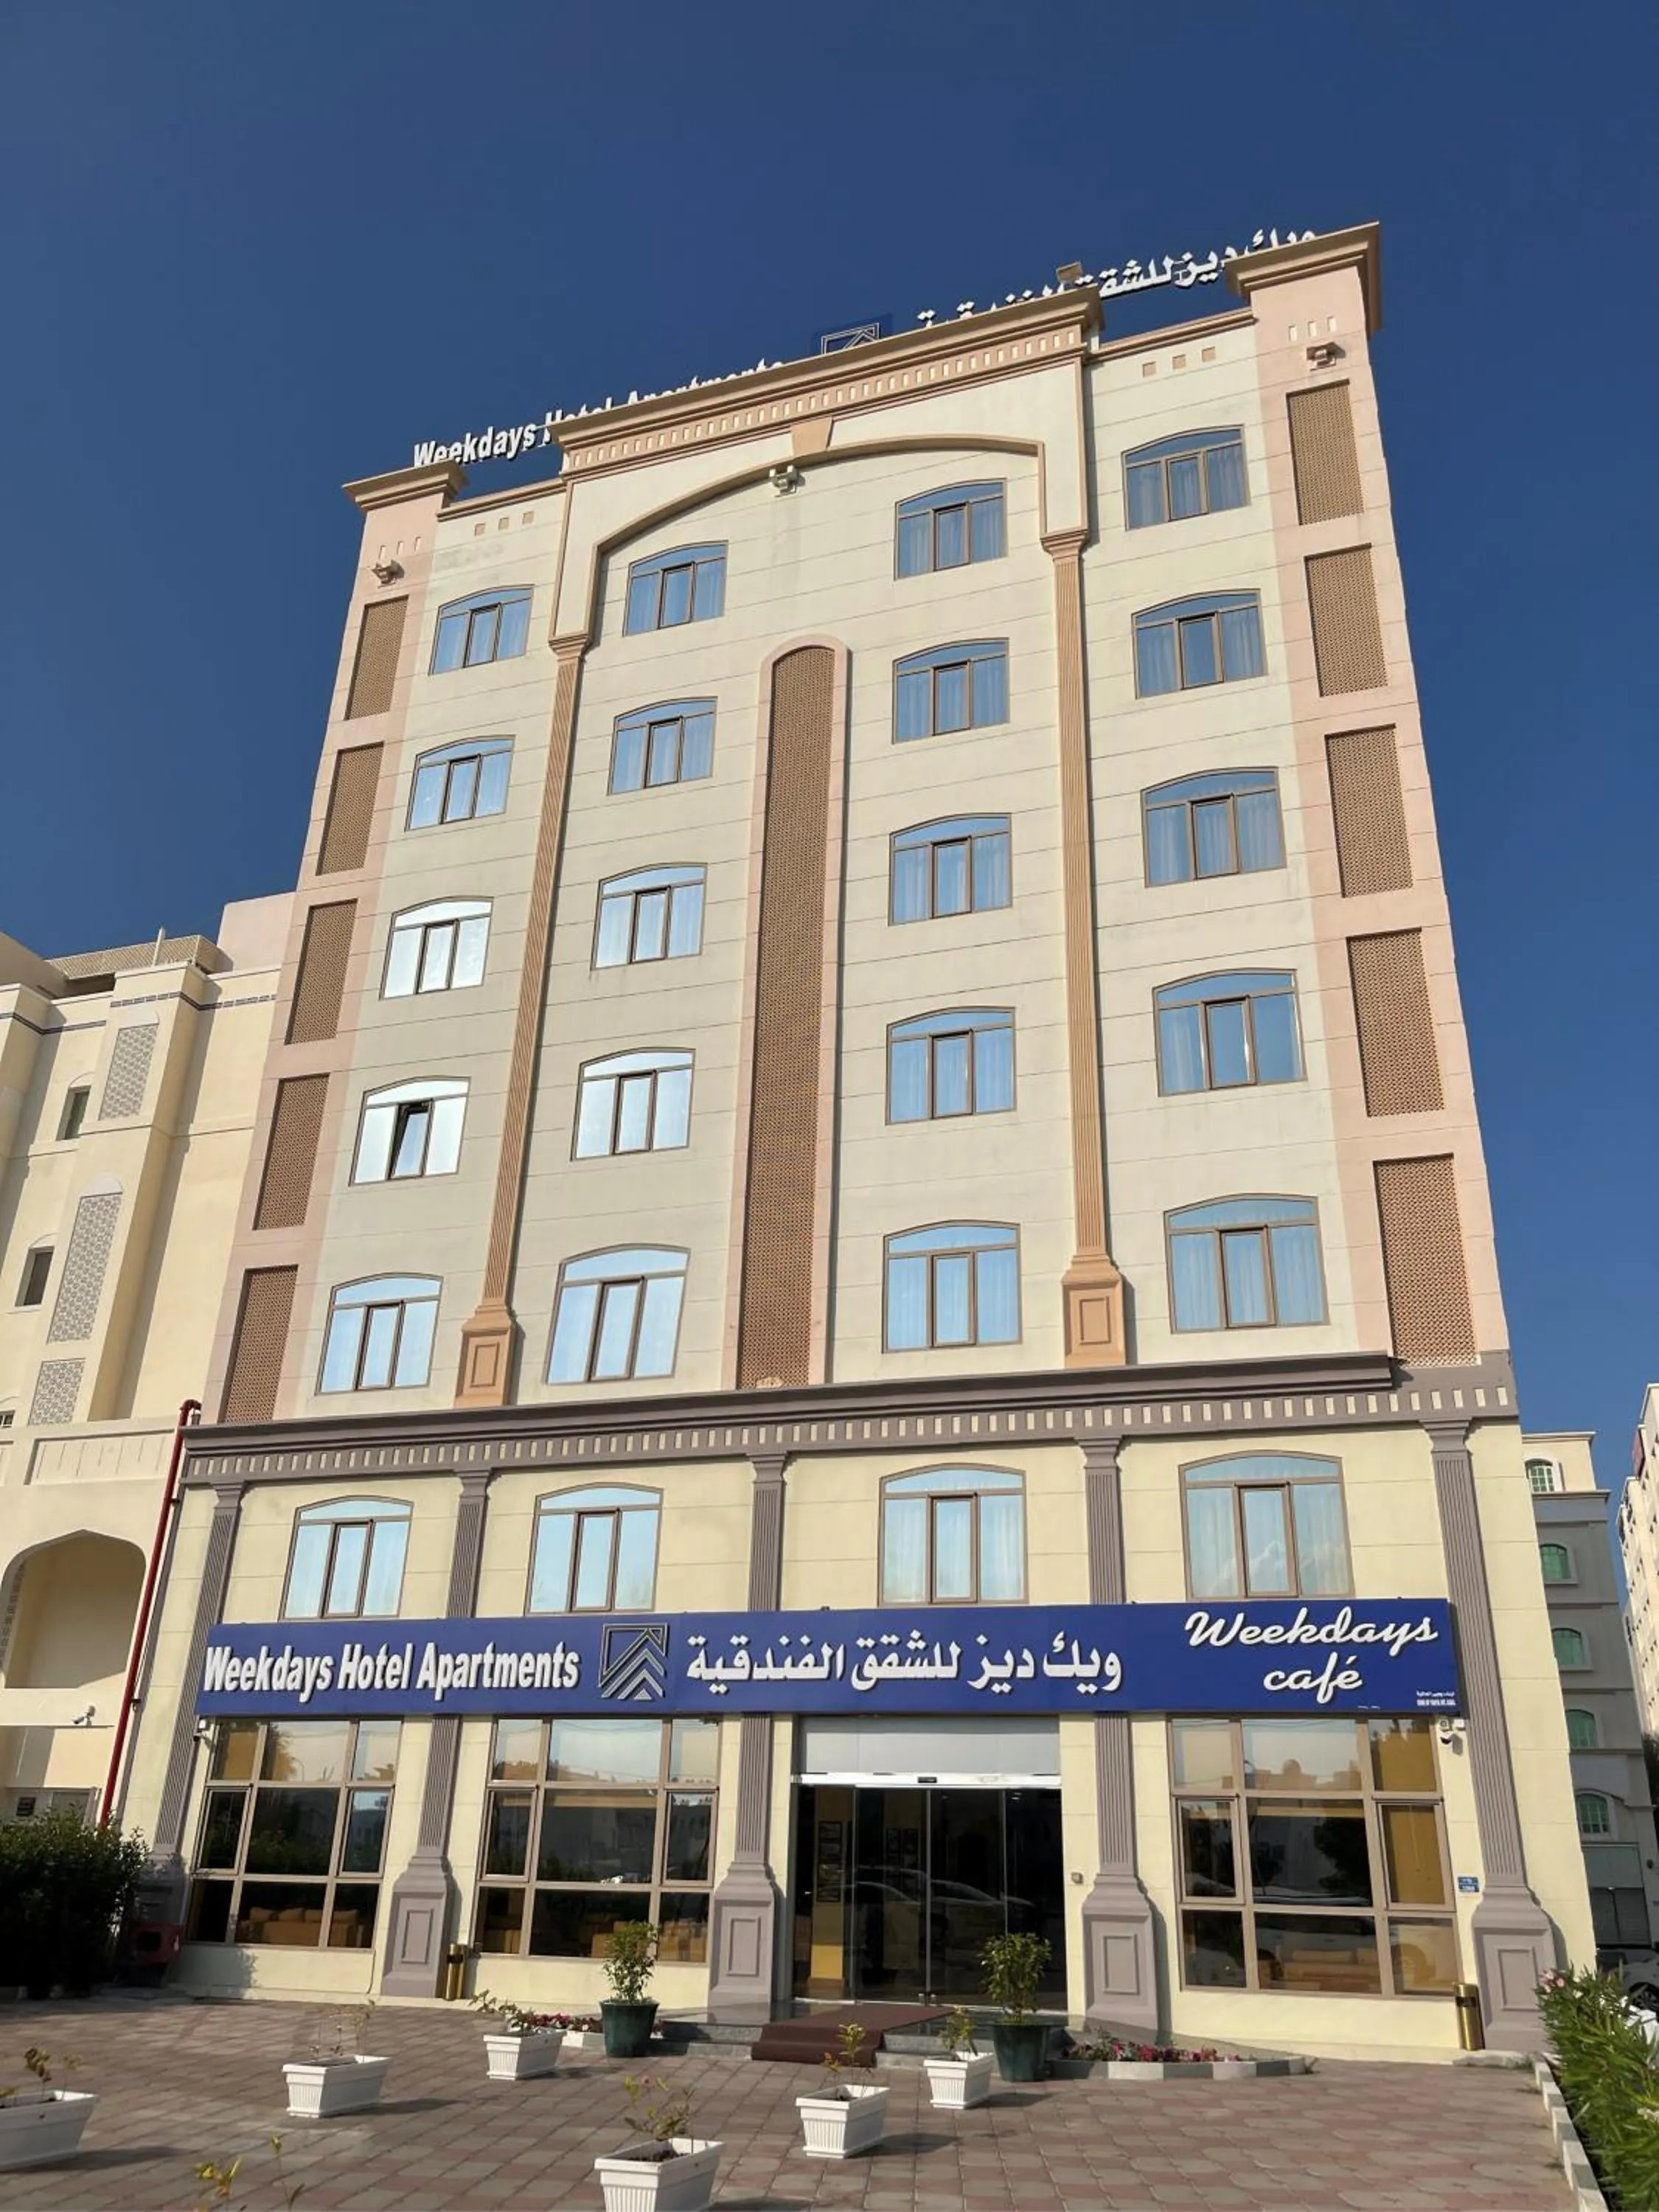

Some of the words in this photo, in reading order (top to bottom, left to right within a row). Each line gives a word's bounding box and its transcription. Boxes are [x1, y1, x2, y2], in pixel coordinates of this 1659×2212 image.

[413, 422, 537, 467] Weekdays
[850, 1629, 961, 1691] للشقق
[1184, 1606, 1439, 1657] Weekdays
[203, 1645, 334, 1703] Weekdays
[337, 1642, 413, 1690] Hotel
[415, 1641, 580, 1701] Apartments
[686, 1634, 845, 1695] الفندقية
[967, 1633, 1034, 1694] ديز
[1263, 1651, 1363, 1705] café
